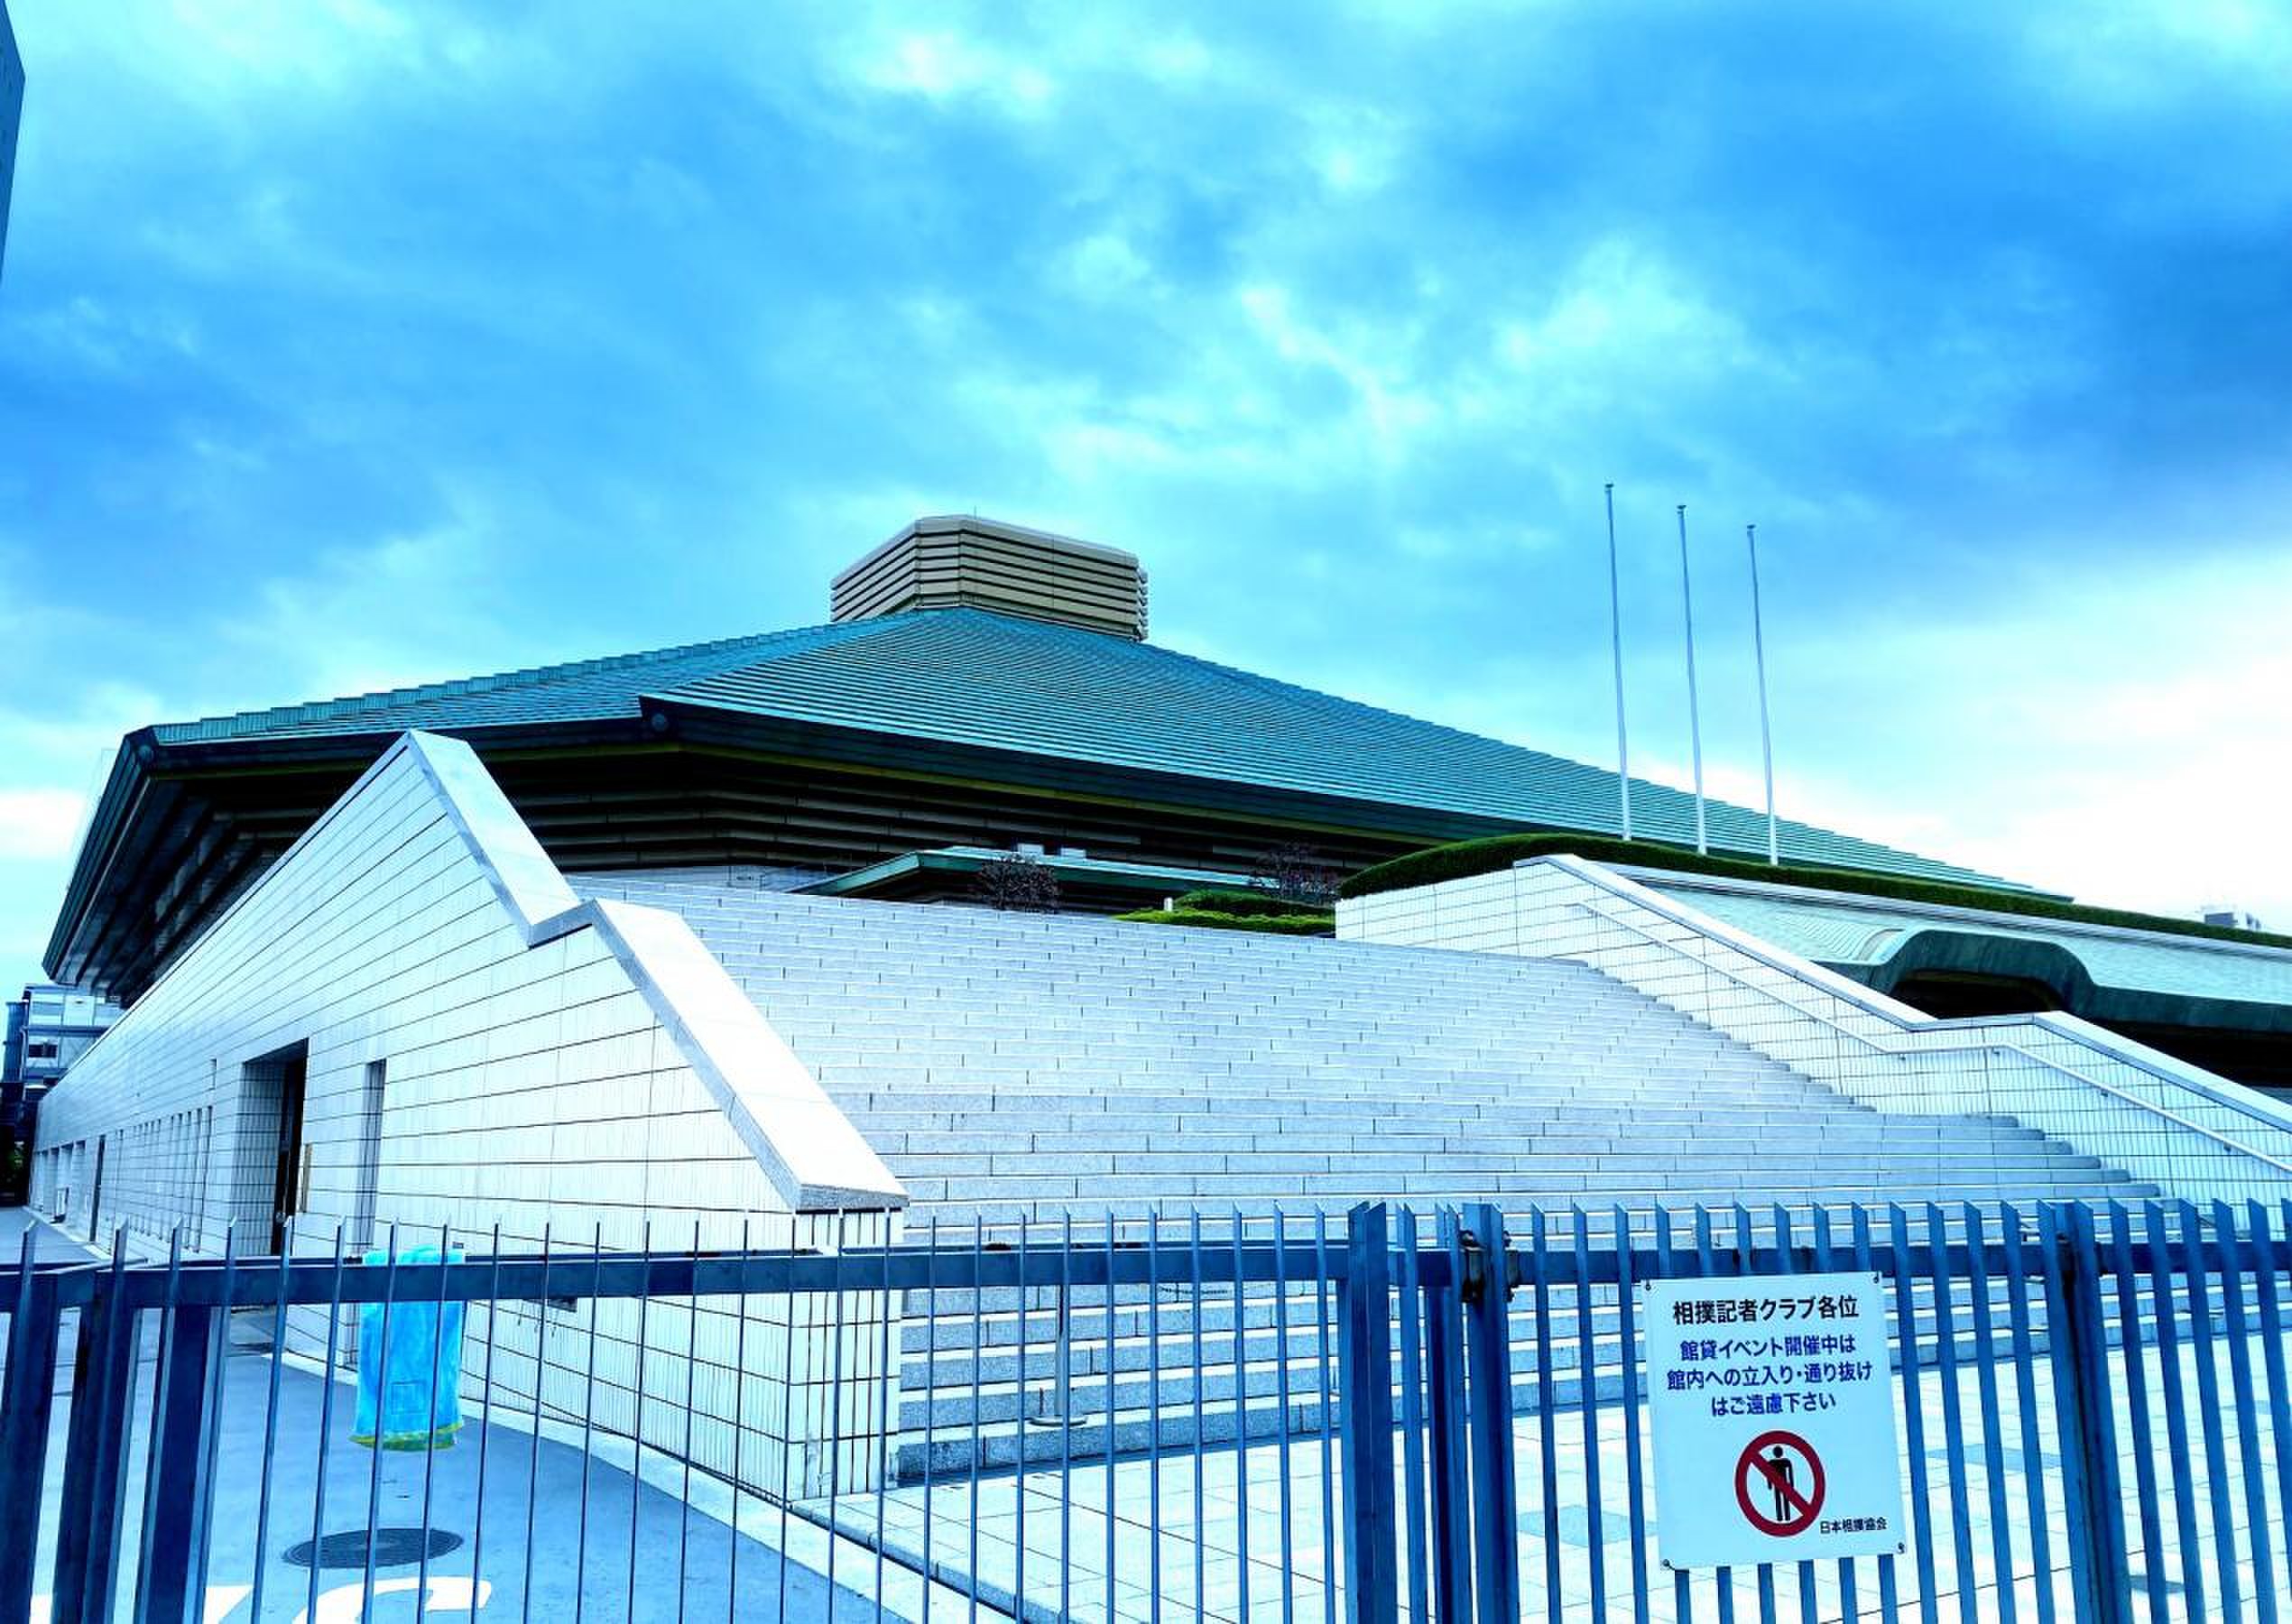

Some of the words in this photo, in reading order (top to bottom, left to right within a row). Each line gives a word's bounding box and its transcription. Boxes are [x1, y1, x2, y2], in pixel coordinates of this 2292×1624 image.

[1673, 1295, 1860, 1324] 相撲記者クラブ各位
[1679, 1333, 1856, 1361] 館貸イベント開催中は
[1711, 1391, 1836, 1416] はご遠慮下さい
[1819, 1517, 1888, 1534] 日本相撲協会
